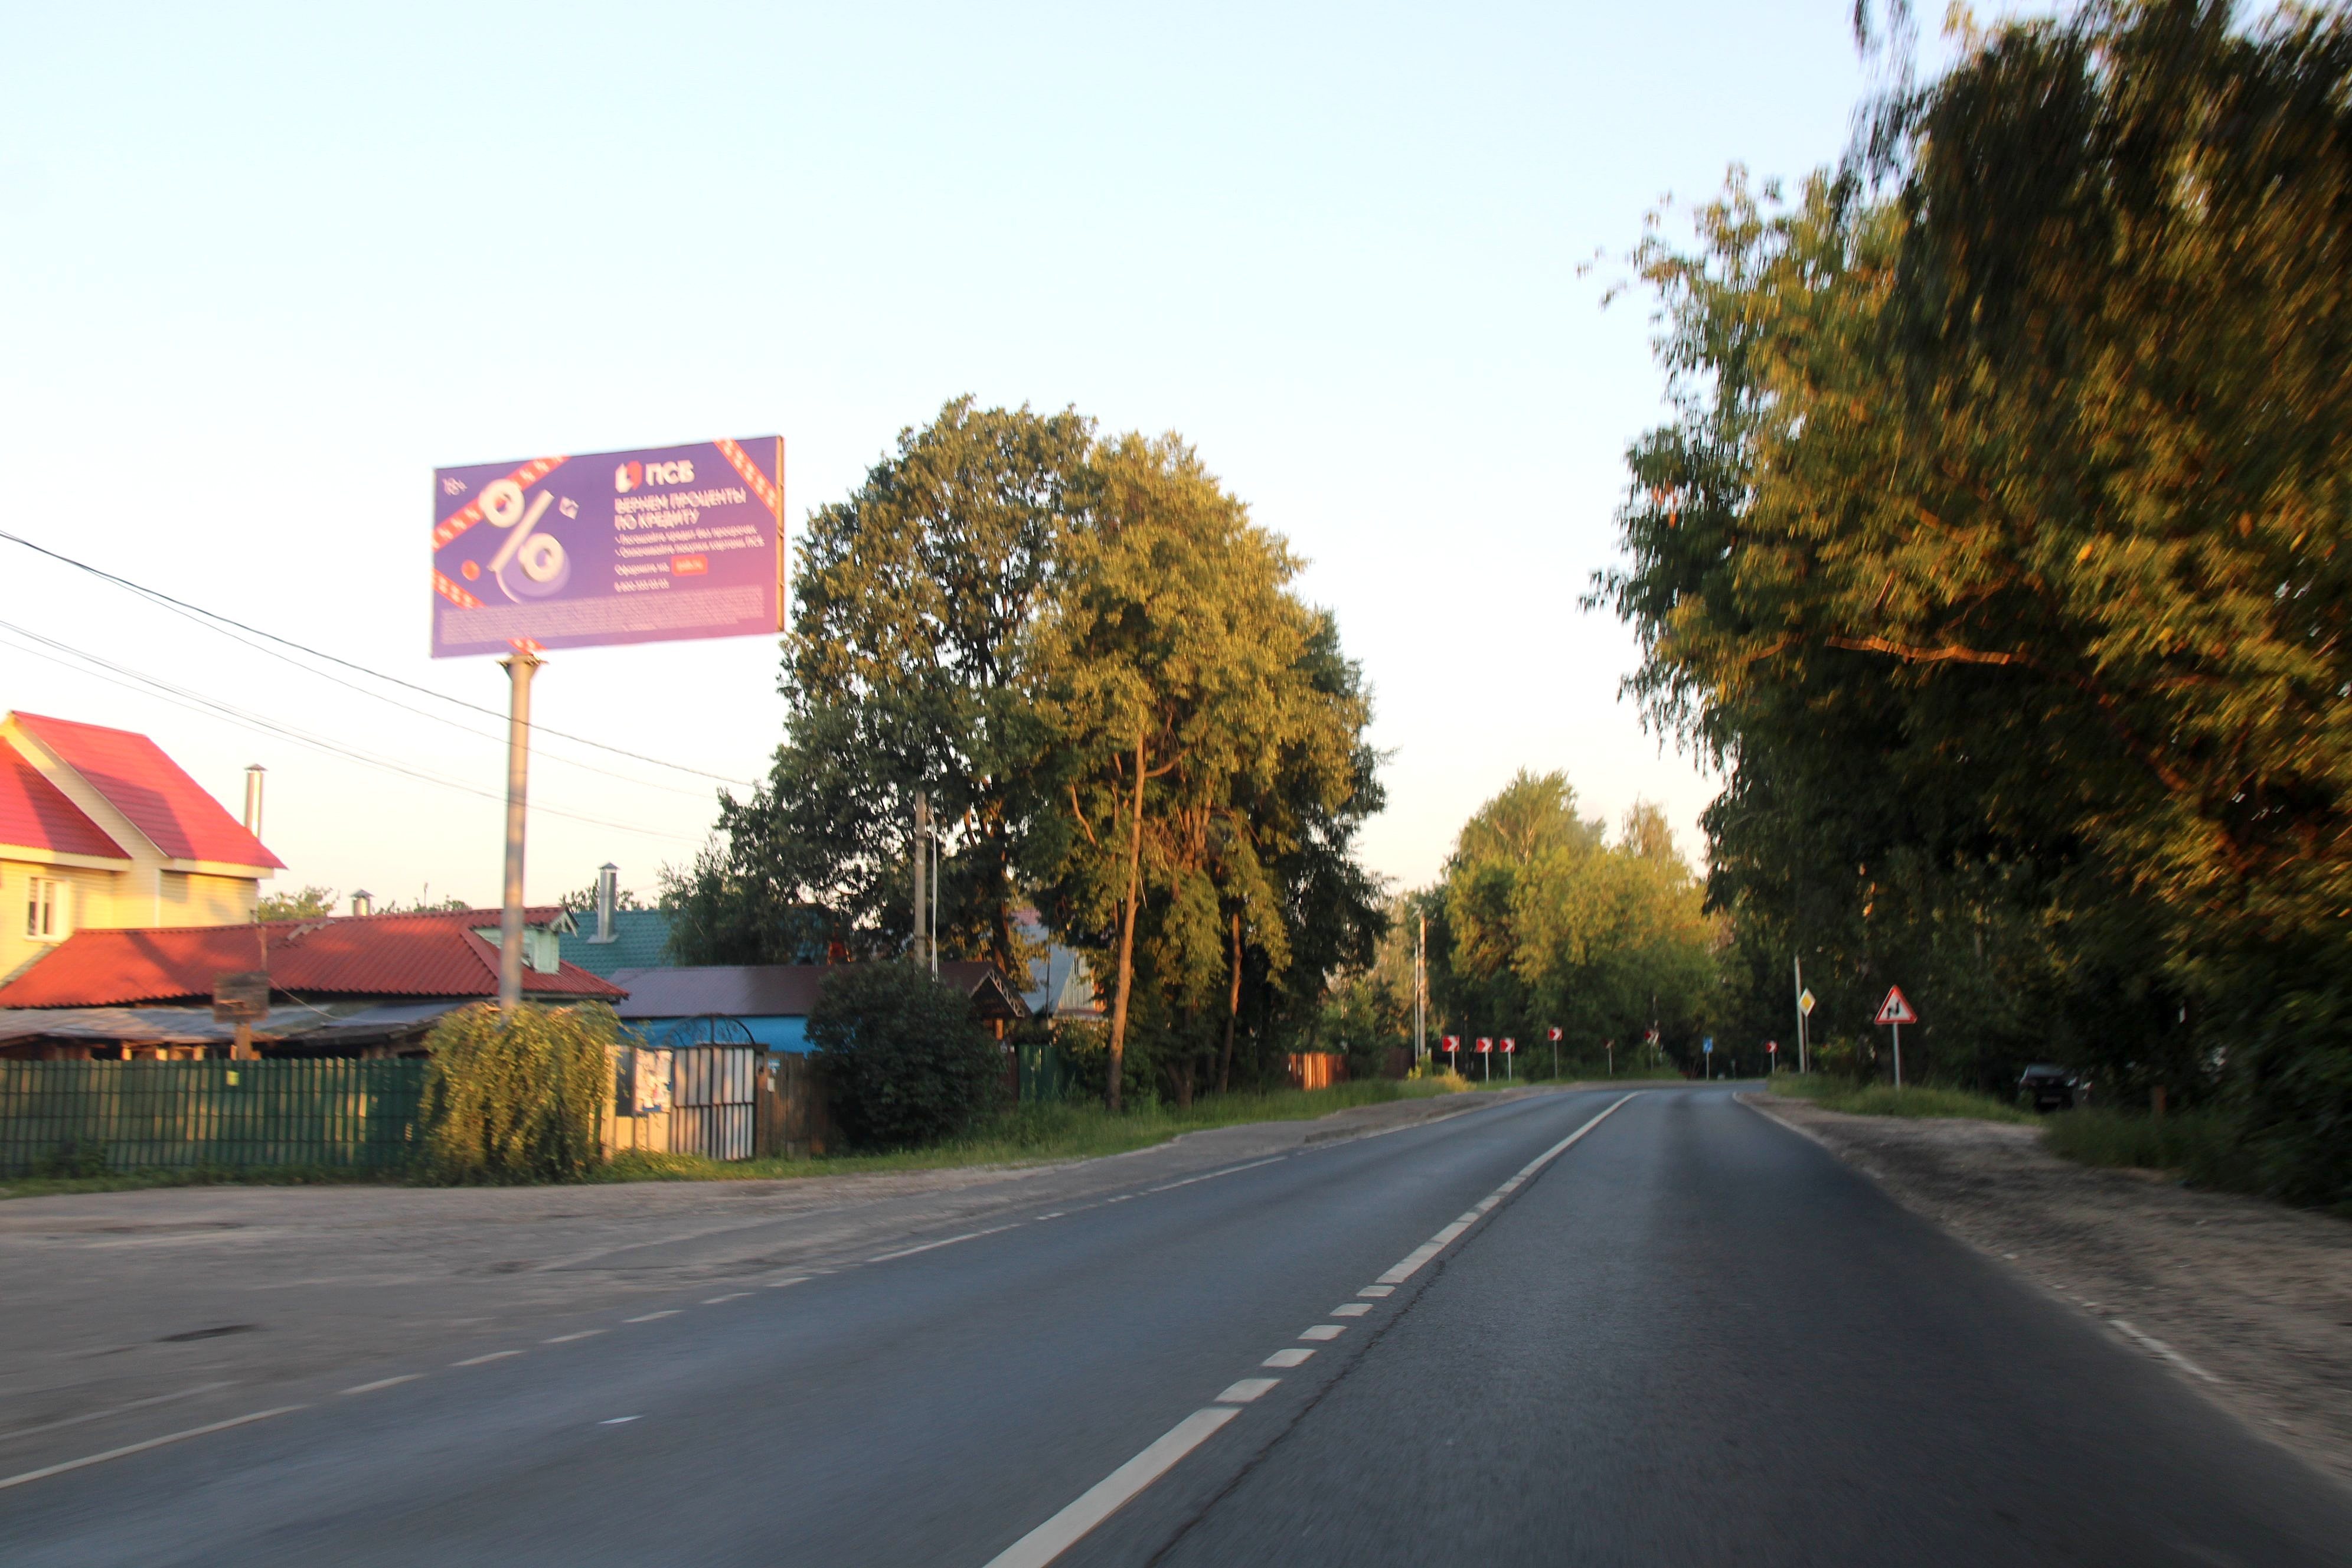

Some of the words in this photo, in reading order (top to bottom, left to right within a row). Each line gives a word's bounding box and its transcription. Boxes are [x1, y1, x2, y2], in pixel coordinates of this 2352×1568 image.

[646, 460, 695, 485] ПСБ
[669, 487, 746, 508] ПРОЦЕНТЫ
[615, 514, 638, 531] ПО
[638, 508, 700, 528] КРЕДИТУ
[746, 534, 765, 547] ПСБ
